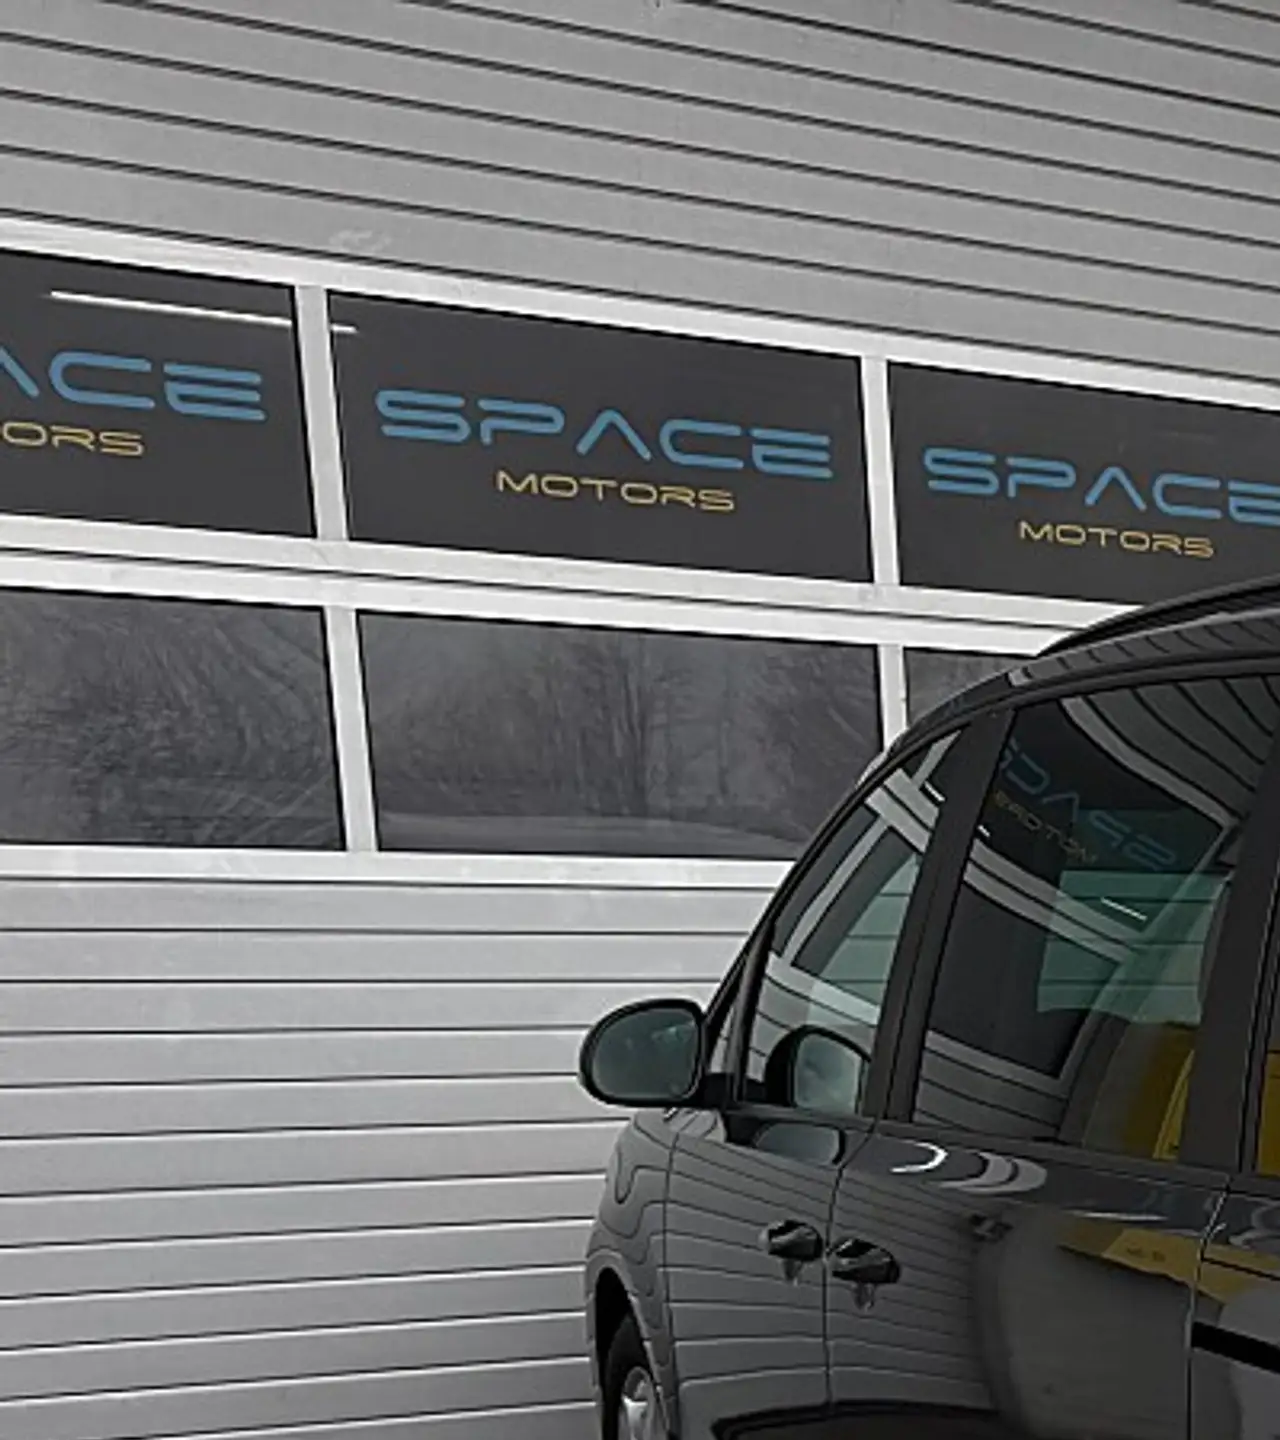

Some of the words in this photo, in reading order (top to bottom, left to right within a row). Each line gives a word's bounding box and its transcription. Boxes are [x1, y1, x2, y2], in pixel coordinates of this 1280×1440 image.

[375, 389, 833, 478] SPACE
[495, 470, 735, 511] MOTORS
[1018, 520, 1215, 559] MOTORS
